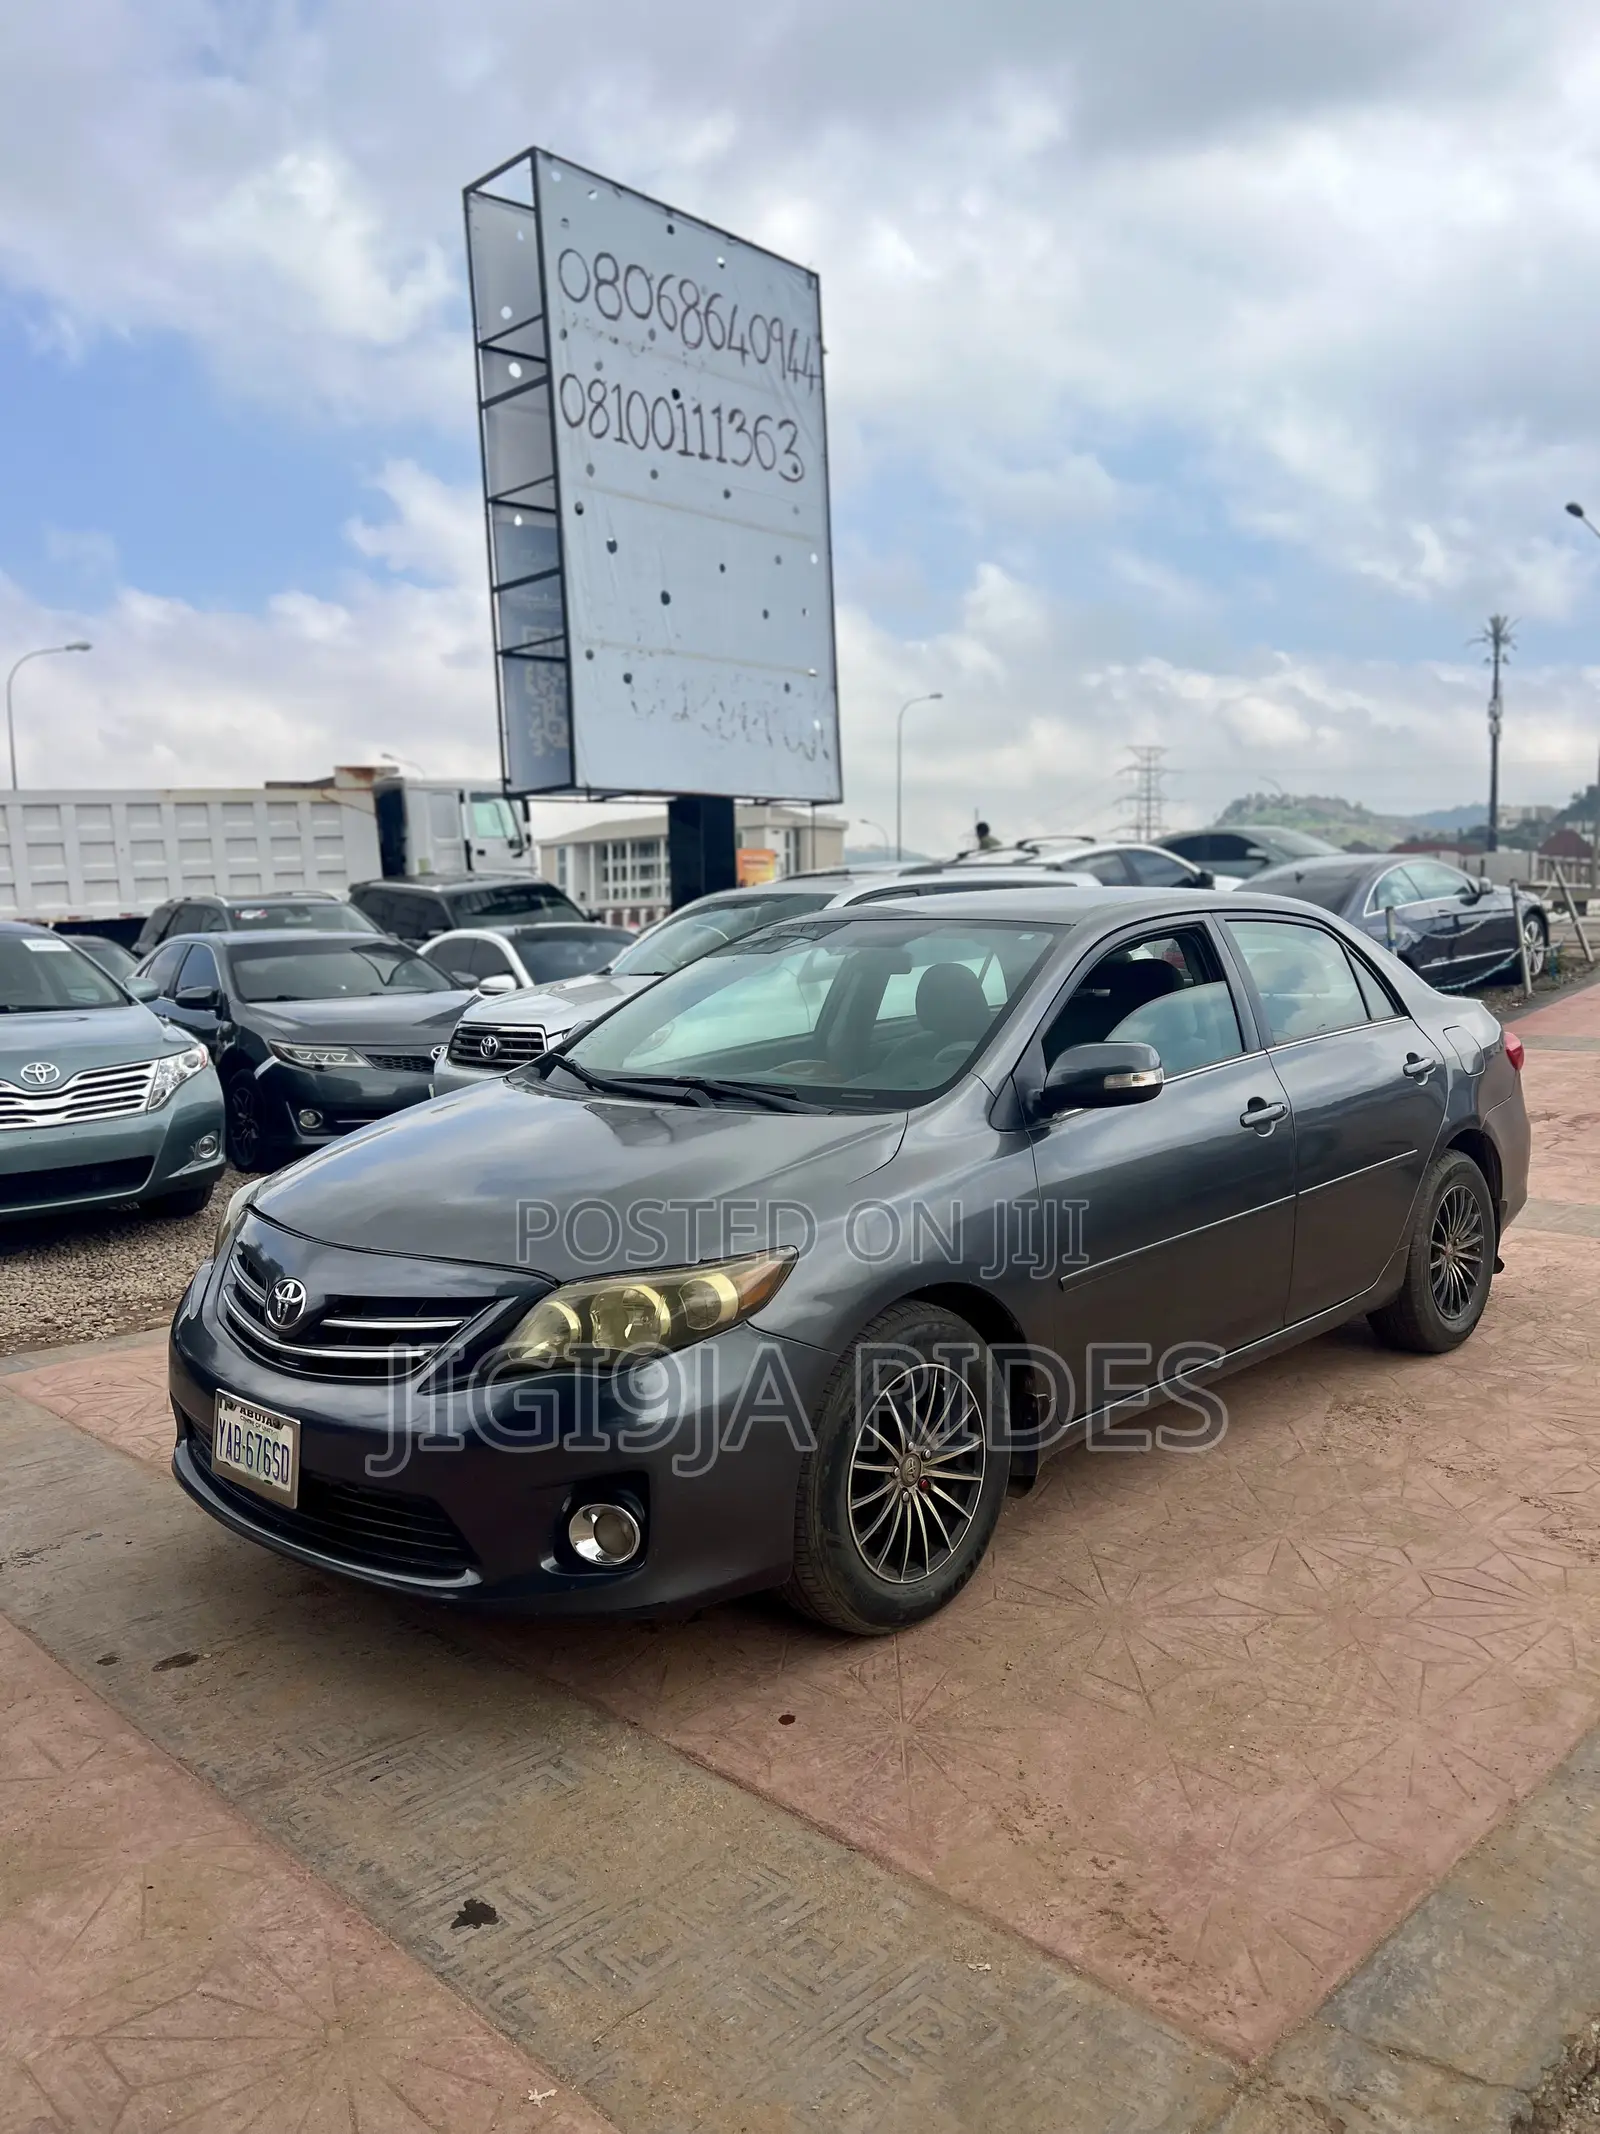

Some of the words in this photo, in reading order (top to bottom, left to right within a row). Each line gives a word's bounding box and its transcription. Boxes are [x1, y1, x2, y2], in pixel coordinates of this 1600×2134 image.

[558, 248, 821, 396] 08068640944
[559, 372, 804, 482] 08100111363
[219, 1418, 289, 1484] YAB-676SD
